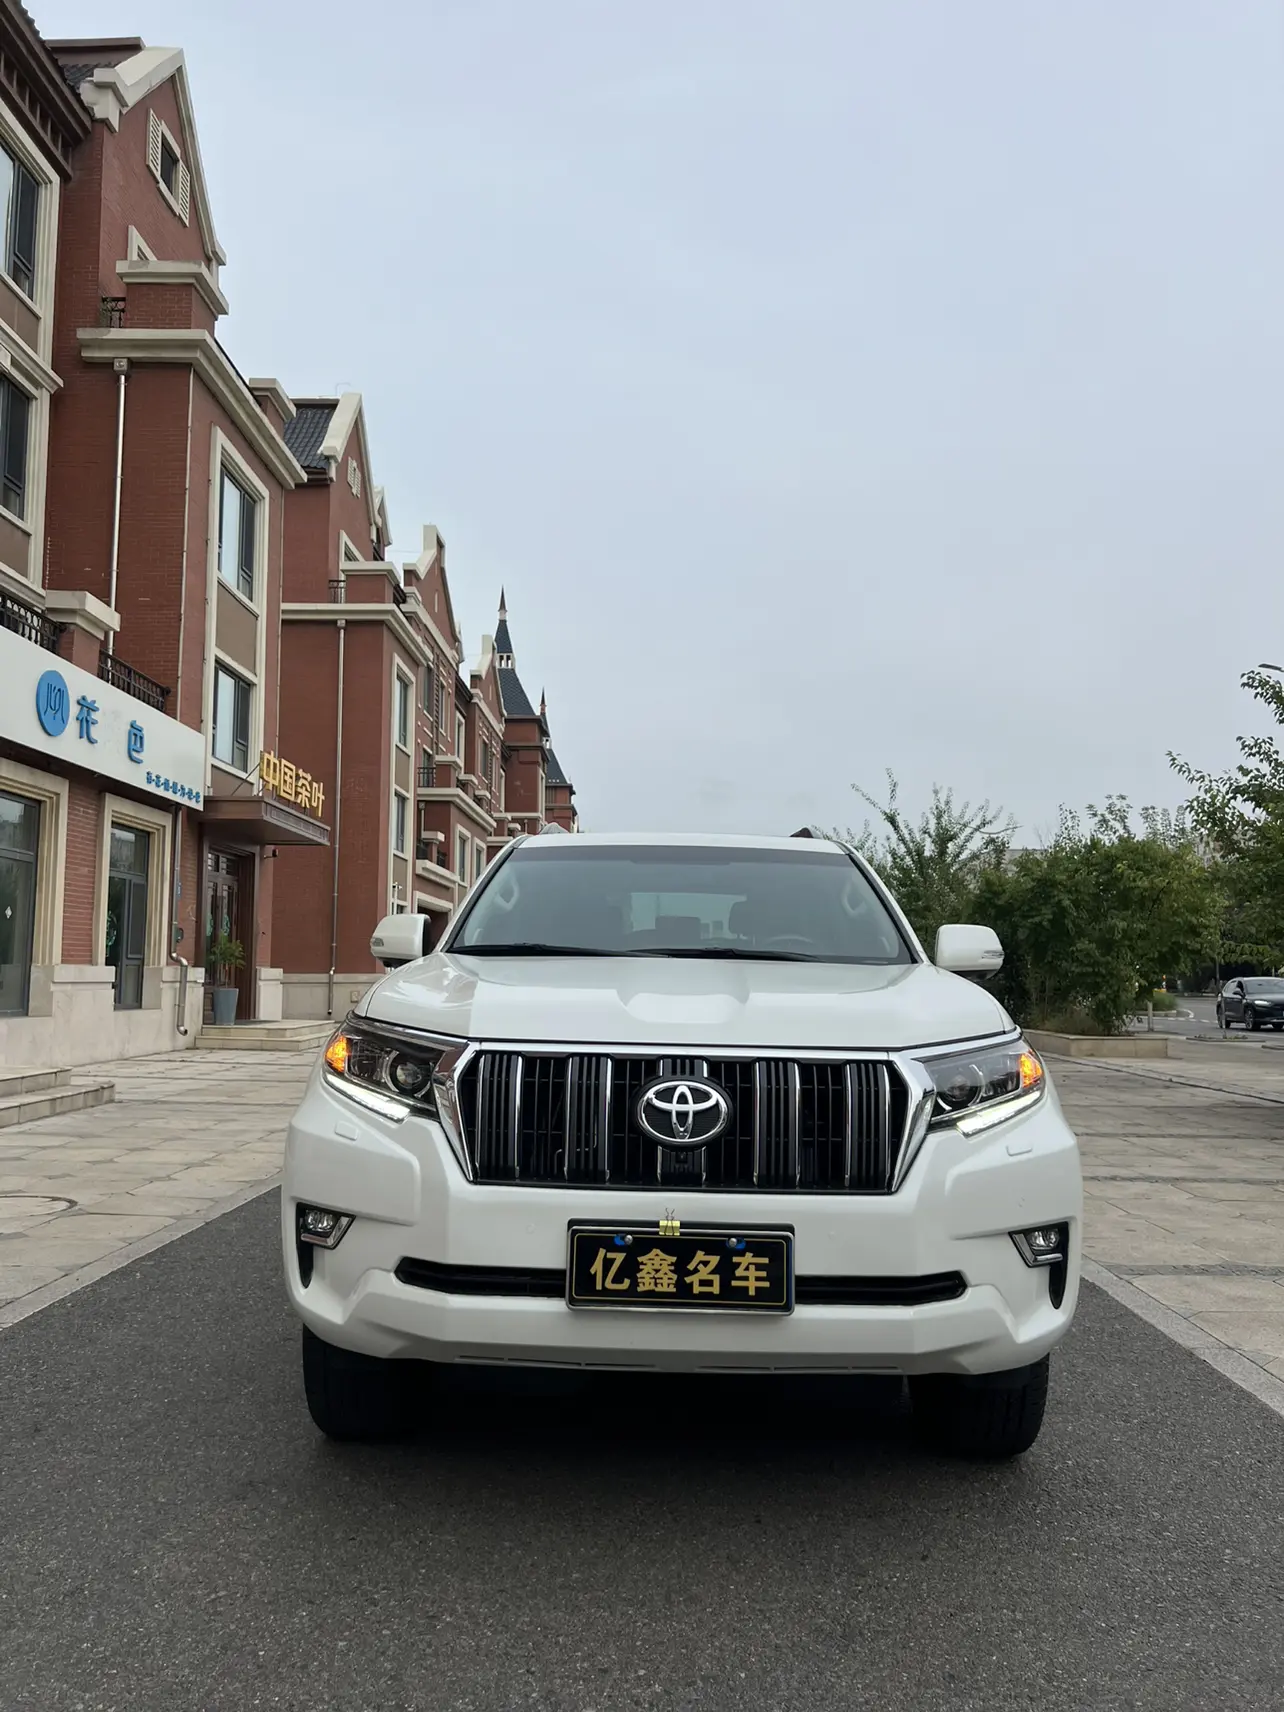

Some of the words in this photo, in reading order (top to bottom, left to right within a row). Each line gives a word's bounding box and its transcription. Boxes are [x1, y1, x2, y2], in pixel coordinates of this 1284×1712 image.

[76, 695, 99, 744] 花
[128, 720, 144, 764] 色
[261, 751, 325, 817] 中国茶叶
[590, 1248, 770, 1295] 亿鑫名车
